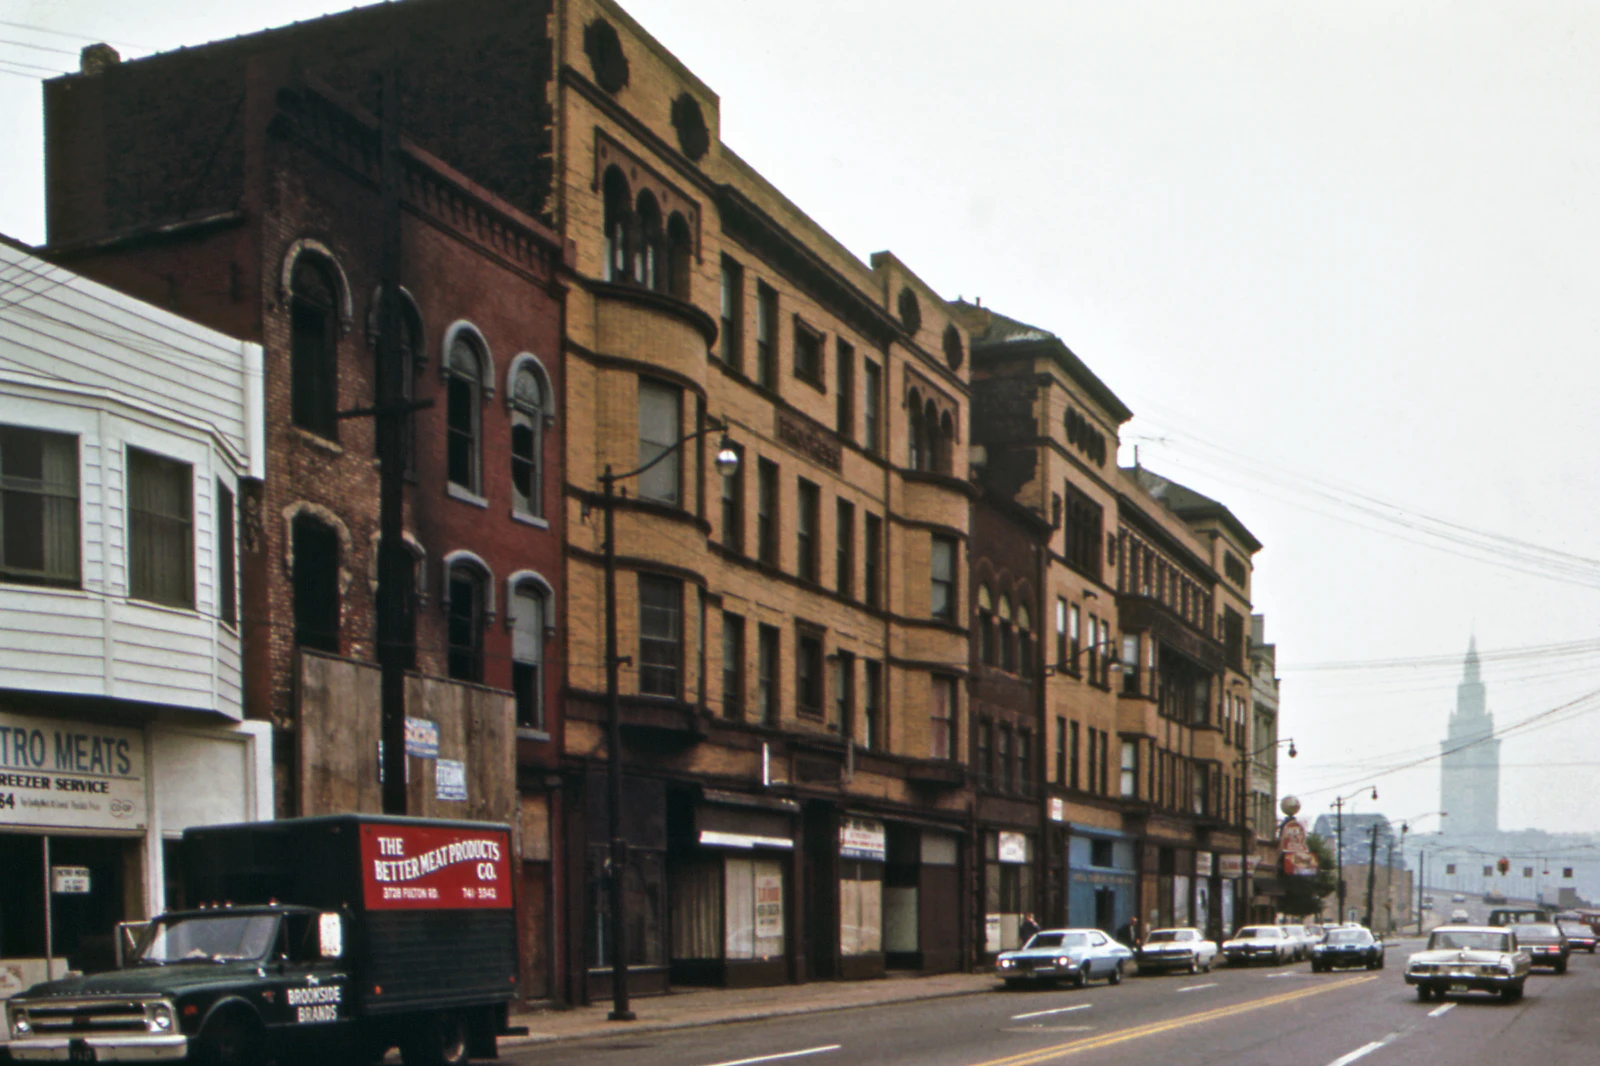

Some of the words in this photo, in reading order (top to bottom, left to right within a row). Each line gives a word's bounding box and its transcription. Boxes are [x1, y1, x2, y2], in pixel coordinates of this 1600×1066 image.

[0, 726, 45, 766] TRO
[54, 732, 130, 774] MEATS
[0, 773, 50, 789] REEZER
[56, 778, 109, 793] SERVICE
[377, 836, 405, 856] THE
[374, 858, 420, 881] BETTER
[419, 846, 448, 875] MEAT
[448, 839, 500, 862] PRODUCTS
[477, 862, 498, 880] CO.
[288, 986, 340, 1005] BROOKSIDE
[298, 1005, 337, 1022] BRANDS
